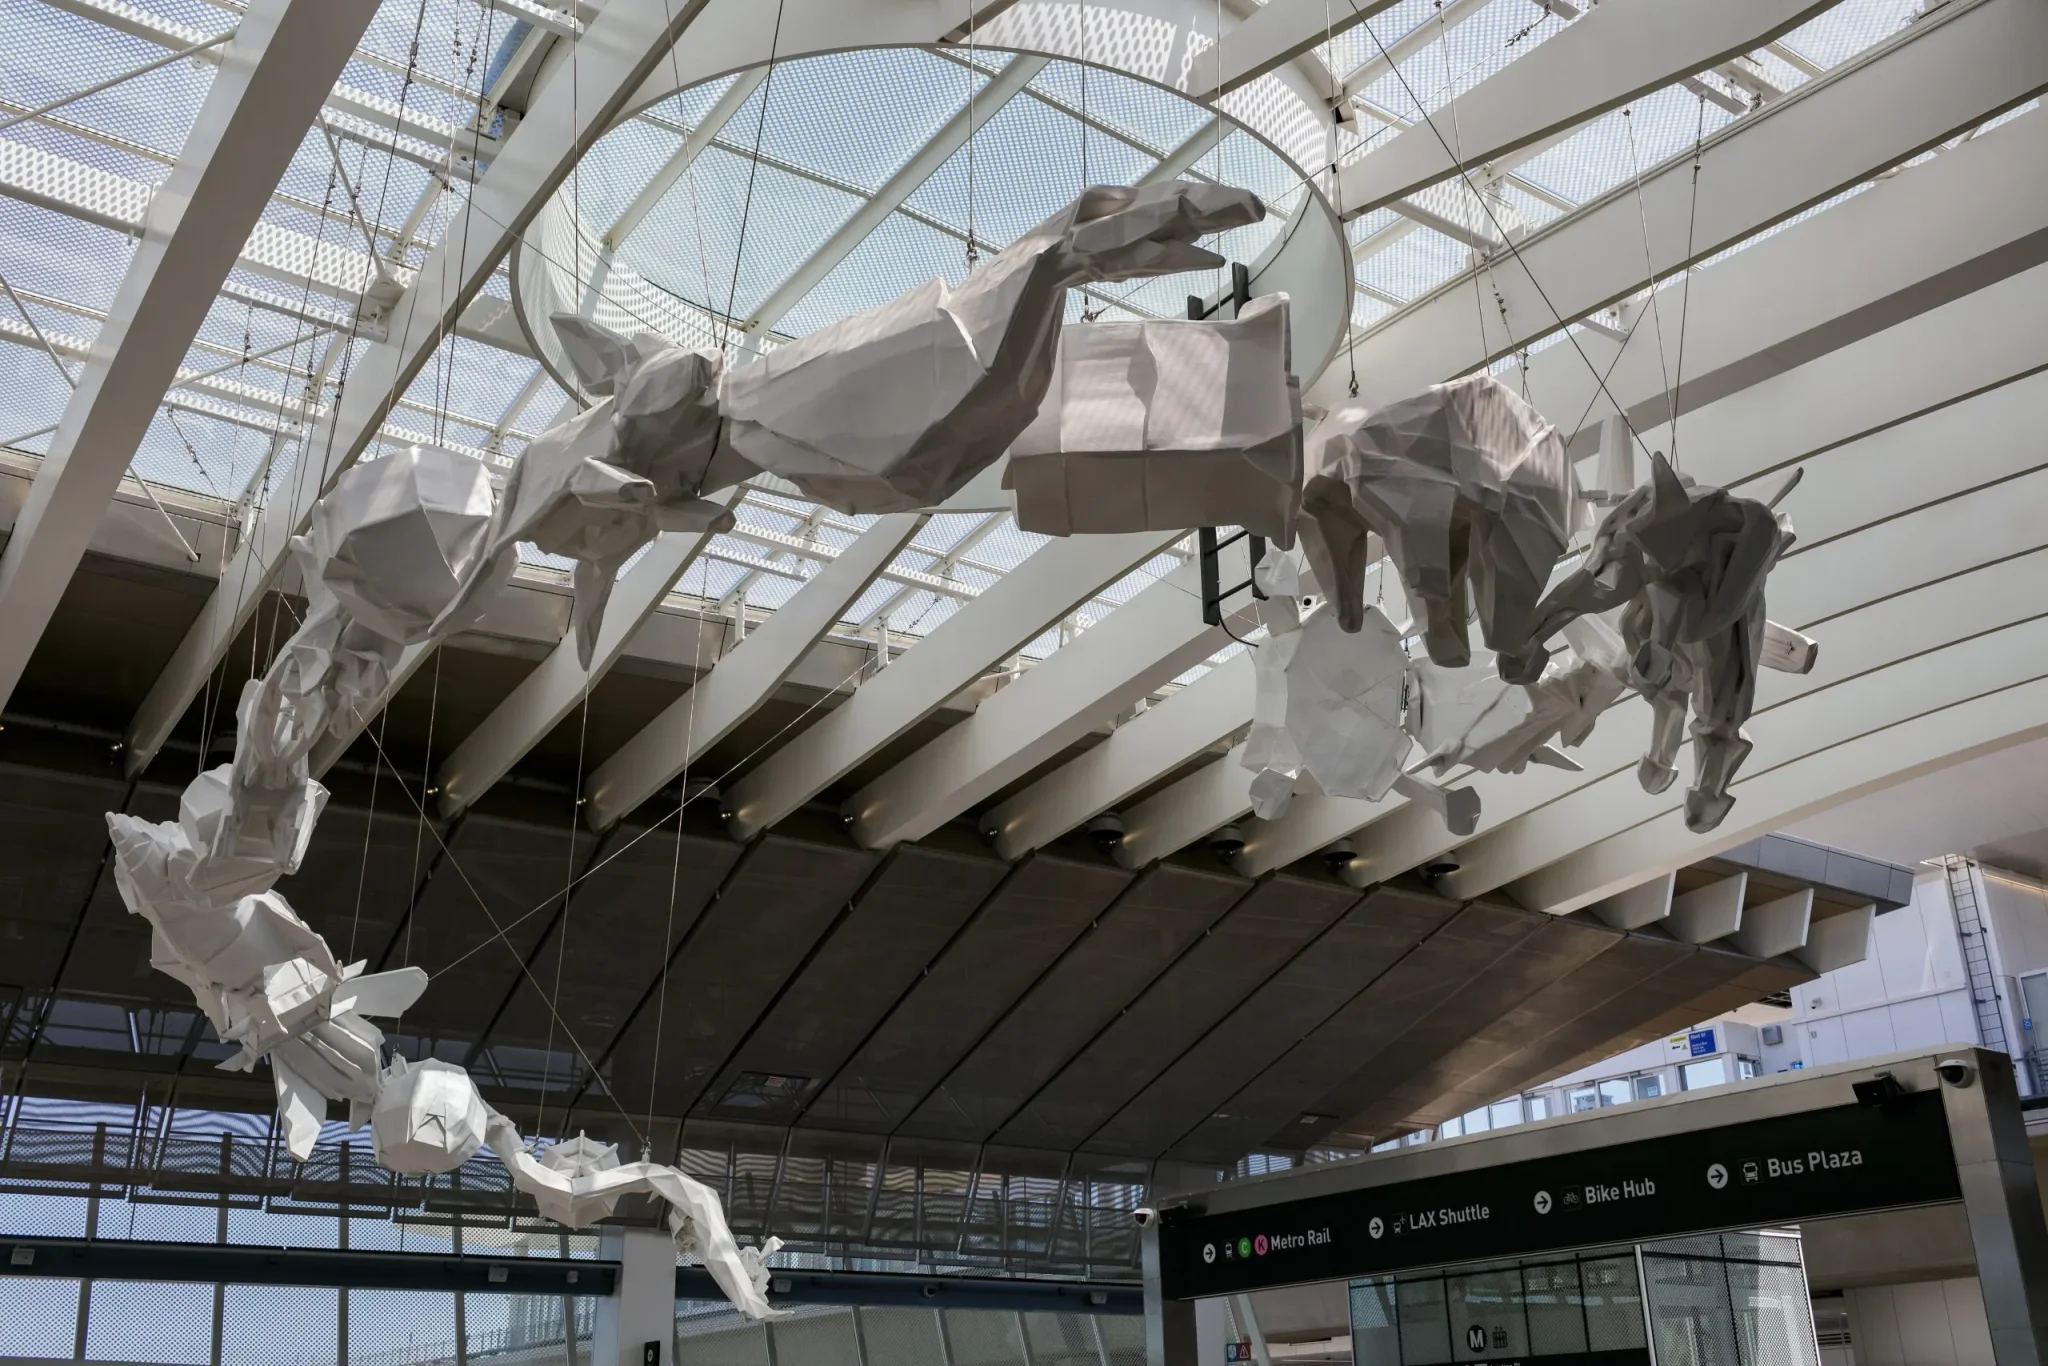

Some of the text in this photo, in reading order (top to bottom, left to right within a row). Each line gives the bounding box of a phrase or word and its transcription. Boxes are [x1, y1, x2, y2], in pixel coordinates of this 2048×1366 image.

[1767, 1150, 1863, 1178] Bus Plaza
[1585, 1178, 1656, 1204] Bike Hub
[1409, 1204, 1490, 1230] LAX Shuttle
[1270, 1235, 1305, 1251] Metro
[1307, 1227, 1332, 1246] Rail
[1469, 1329, 1485, 1349] M
